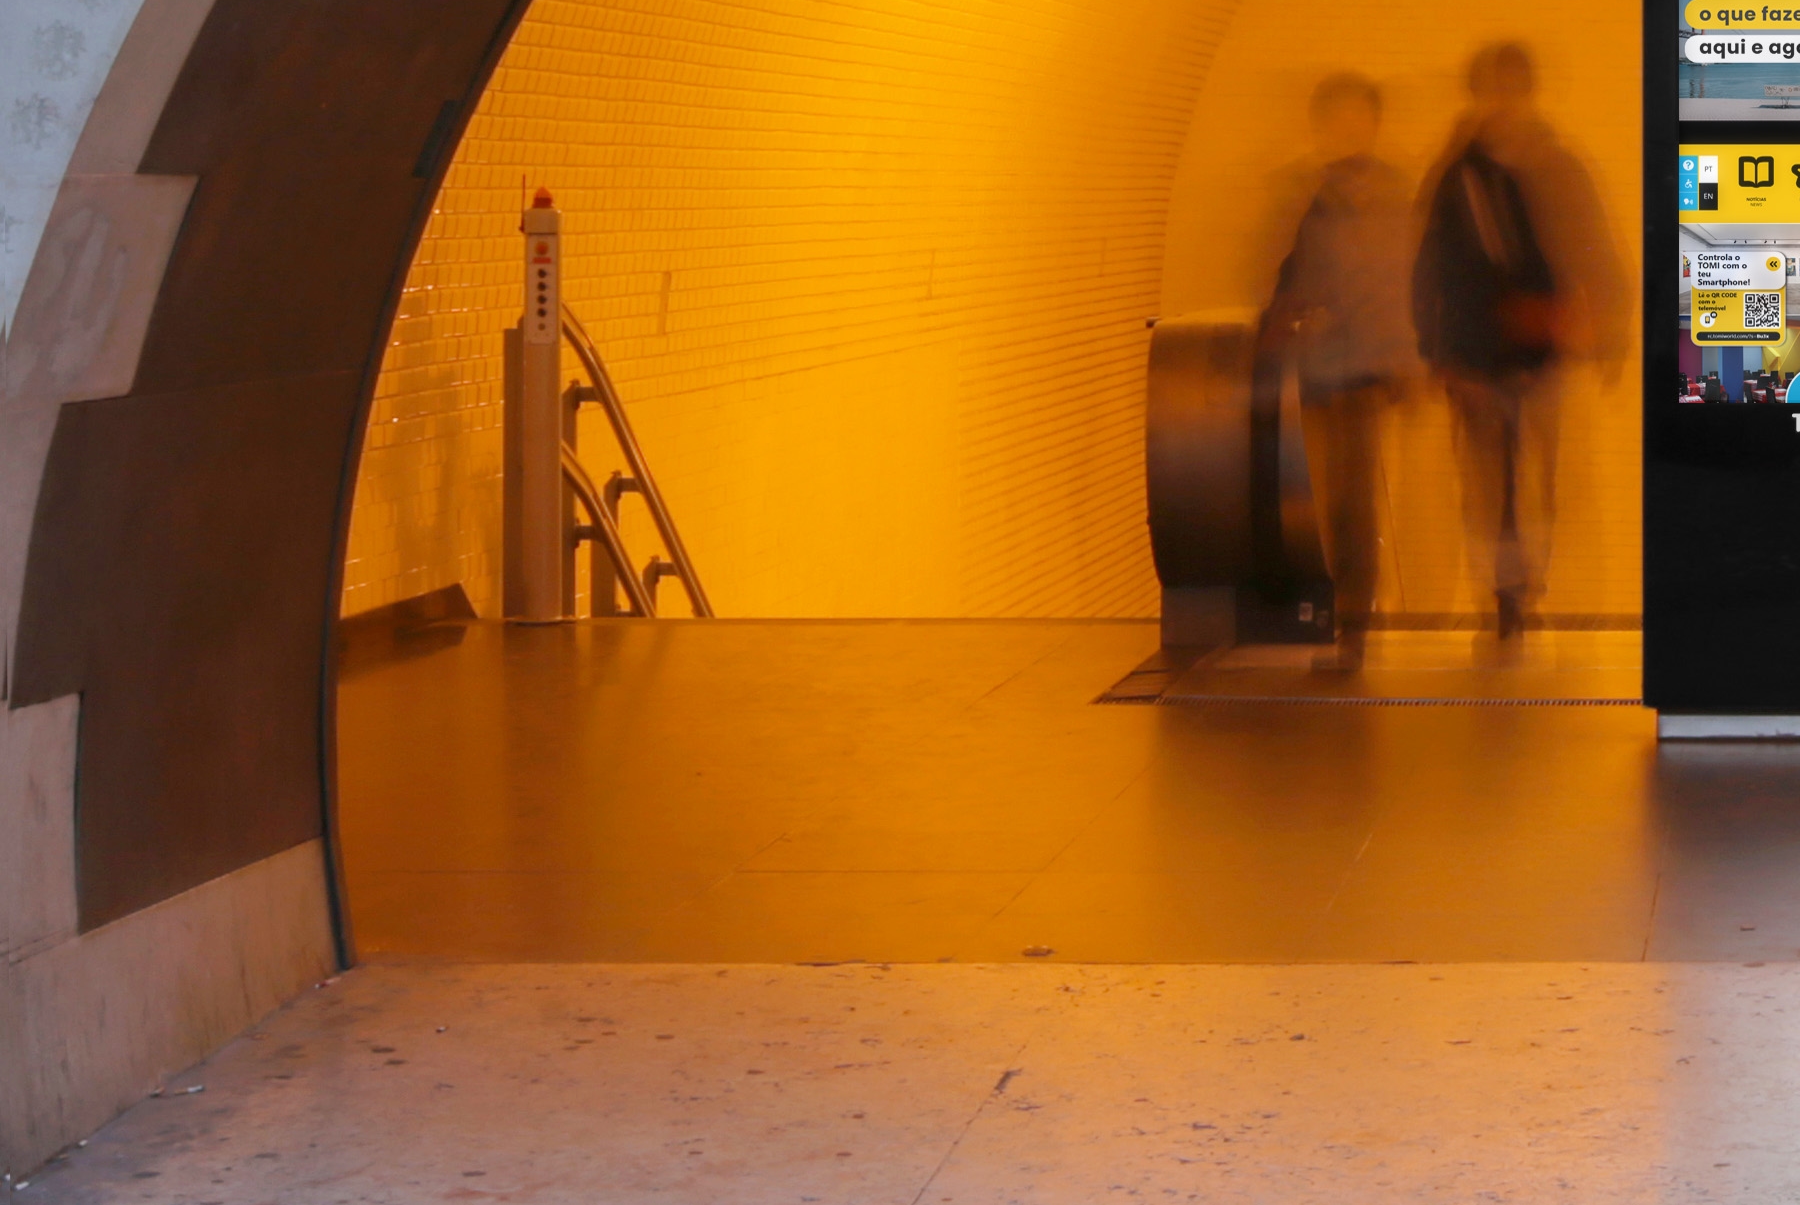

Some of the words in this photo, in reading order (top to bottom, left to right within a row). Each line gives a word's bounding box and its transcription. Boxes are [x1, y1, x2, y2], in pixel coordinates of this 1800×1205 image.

[1699, 9, 1712, 21] o
[1717, 9, 1756, 26] que
[1699, 38, 1746, 59] aqui
[1751, 42, 1763, 55] e
[1698, 279, 1750, 287] Smartphone!
